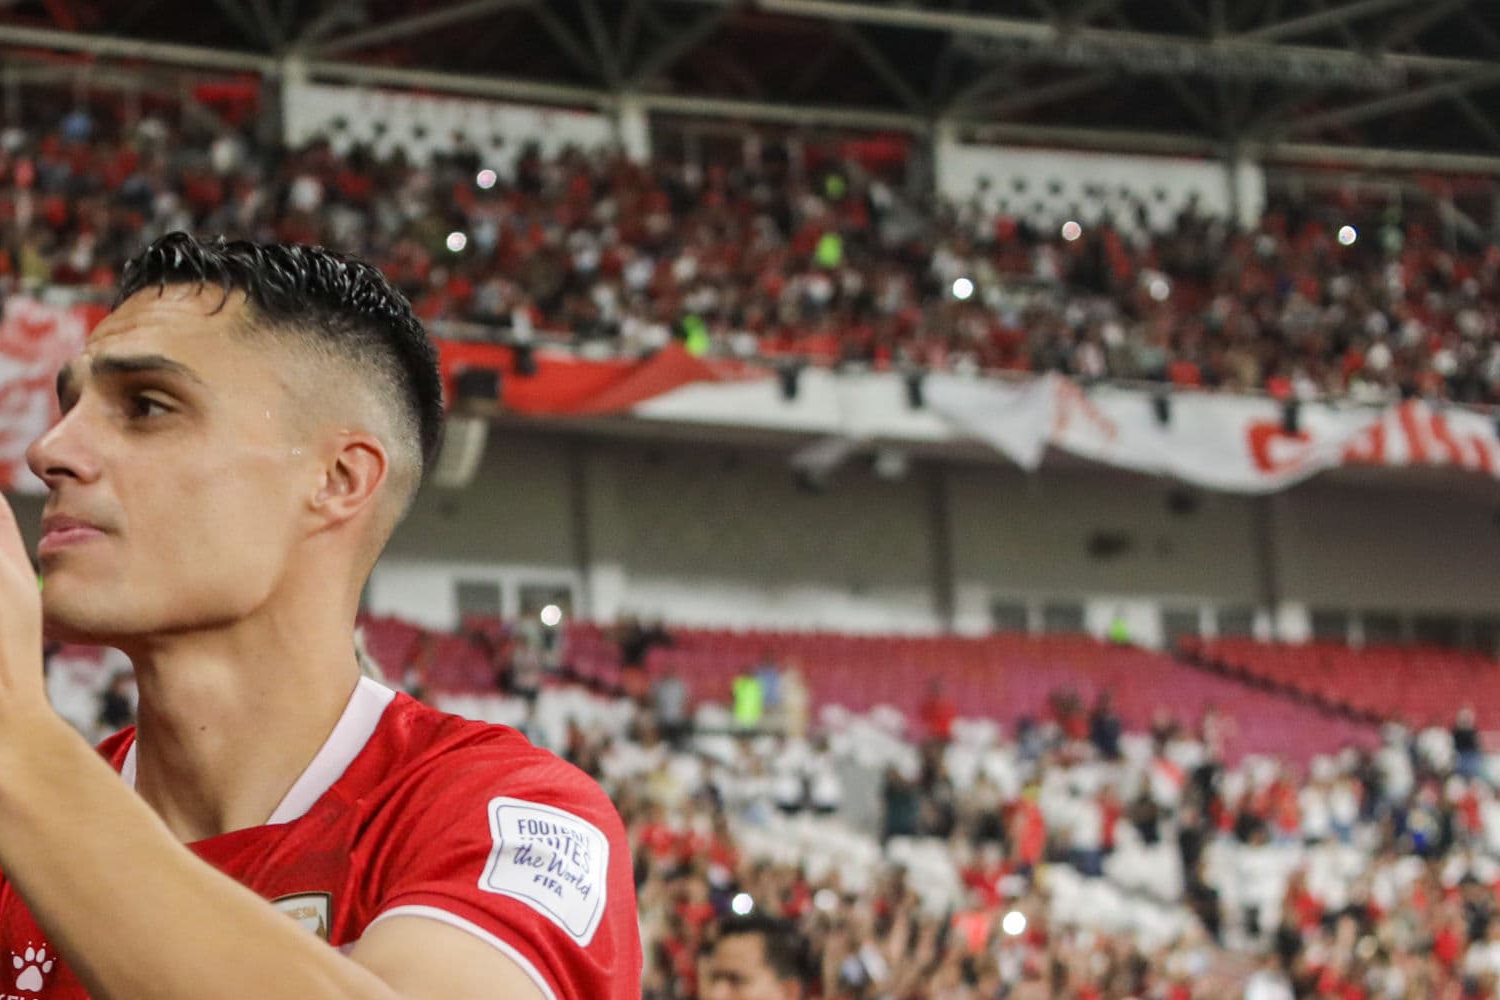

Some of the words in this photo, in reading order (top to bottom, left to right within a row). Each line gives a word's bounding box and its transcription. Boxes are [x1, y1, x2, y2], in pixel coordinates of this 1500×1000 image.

[513, 842, 545, 868] the
[547, 851, 592, 900] World
[519, 836, 591, 874] ITES
[533, 874, 563, 897] FIFA
